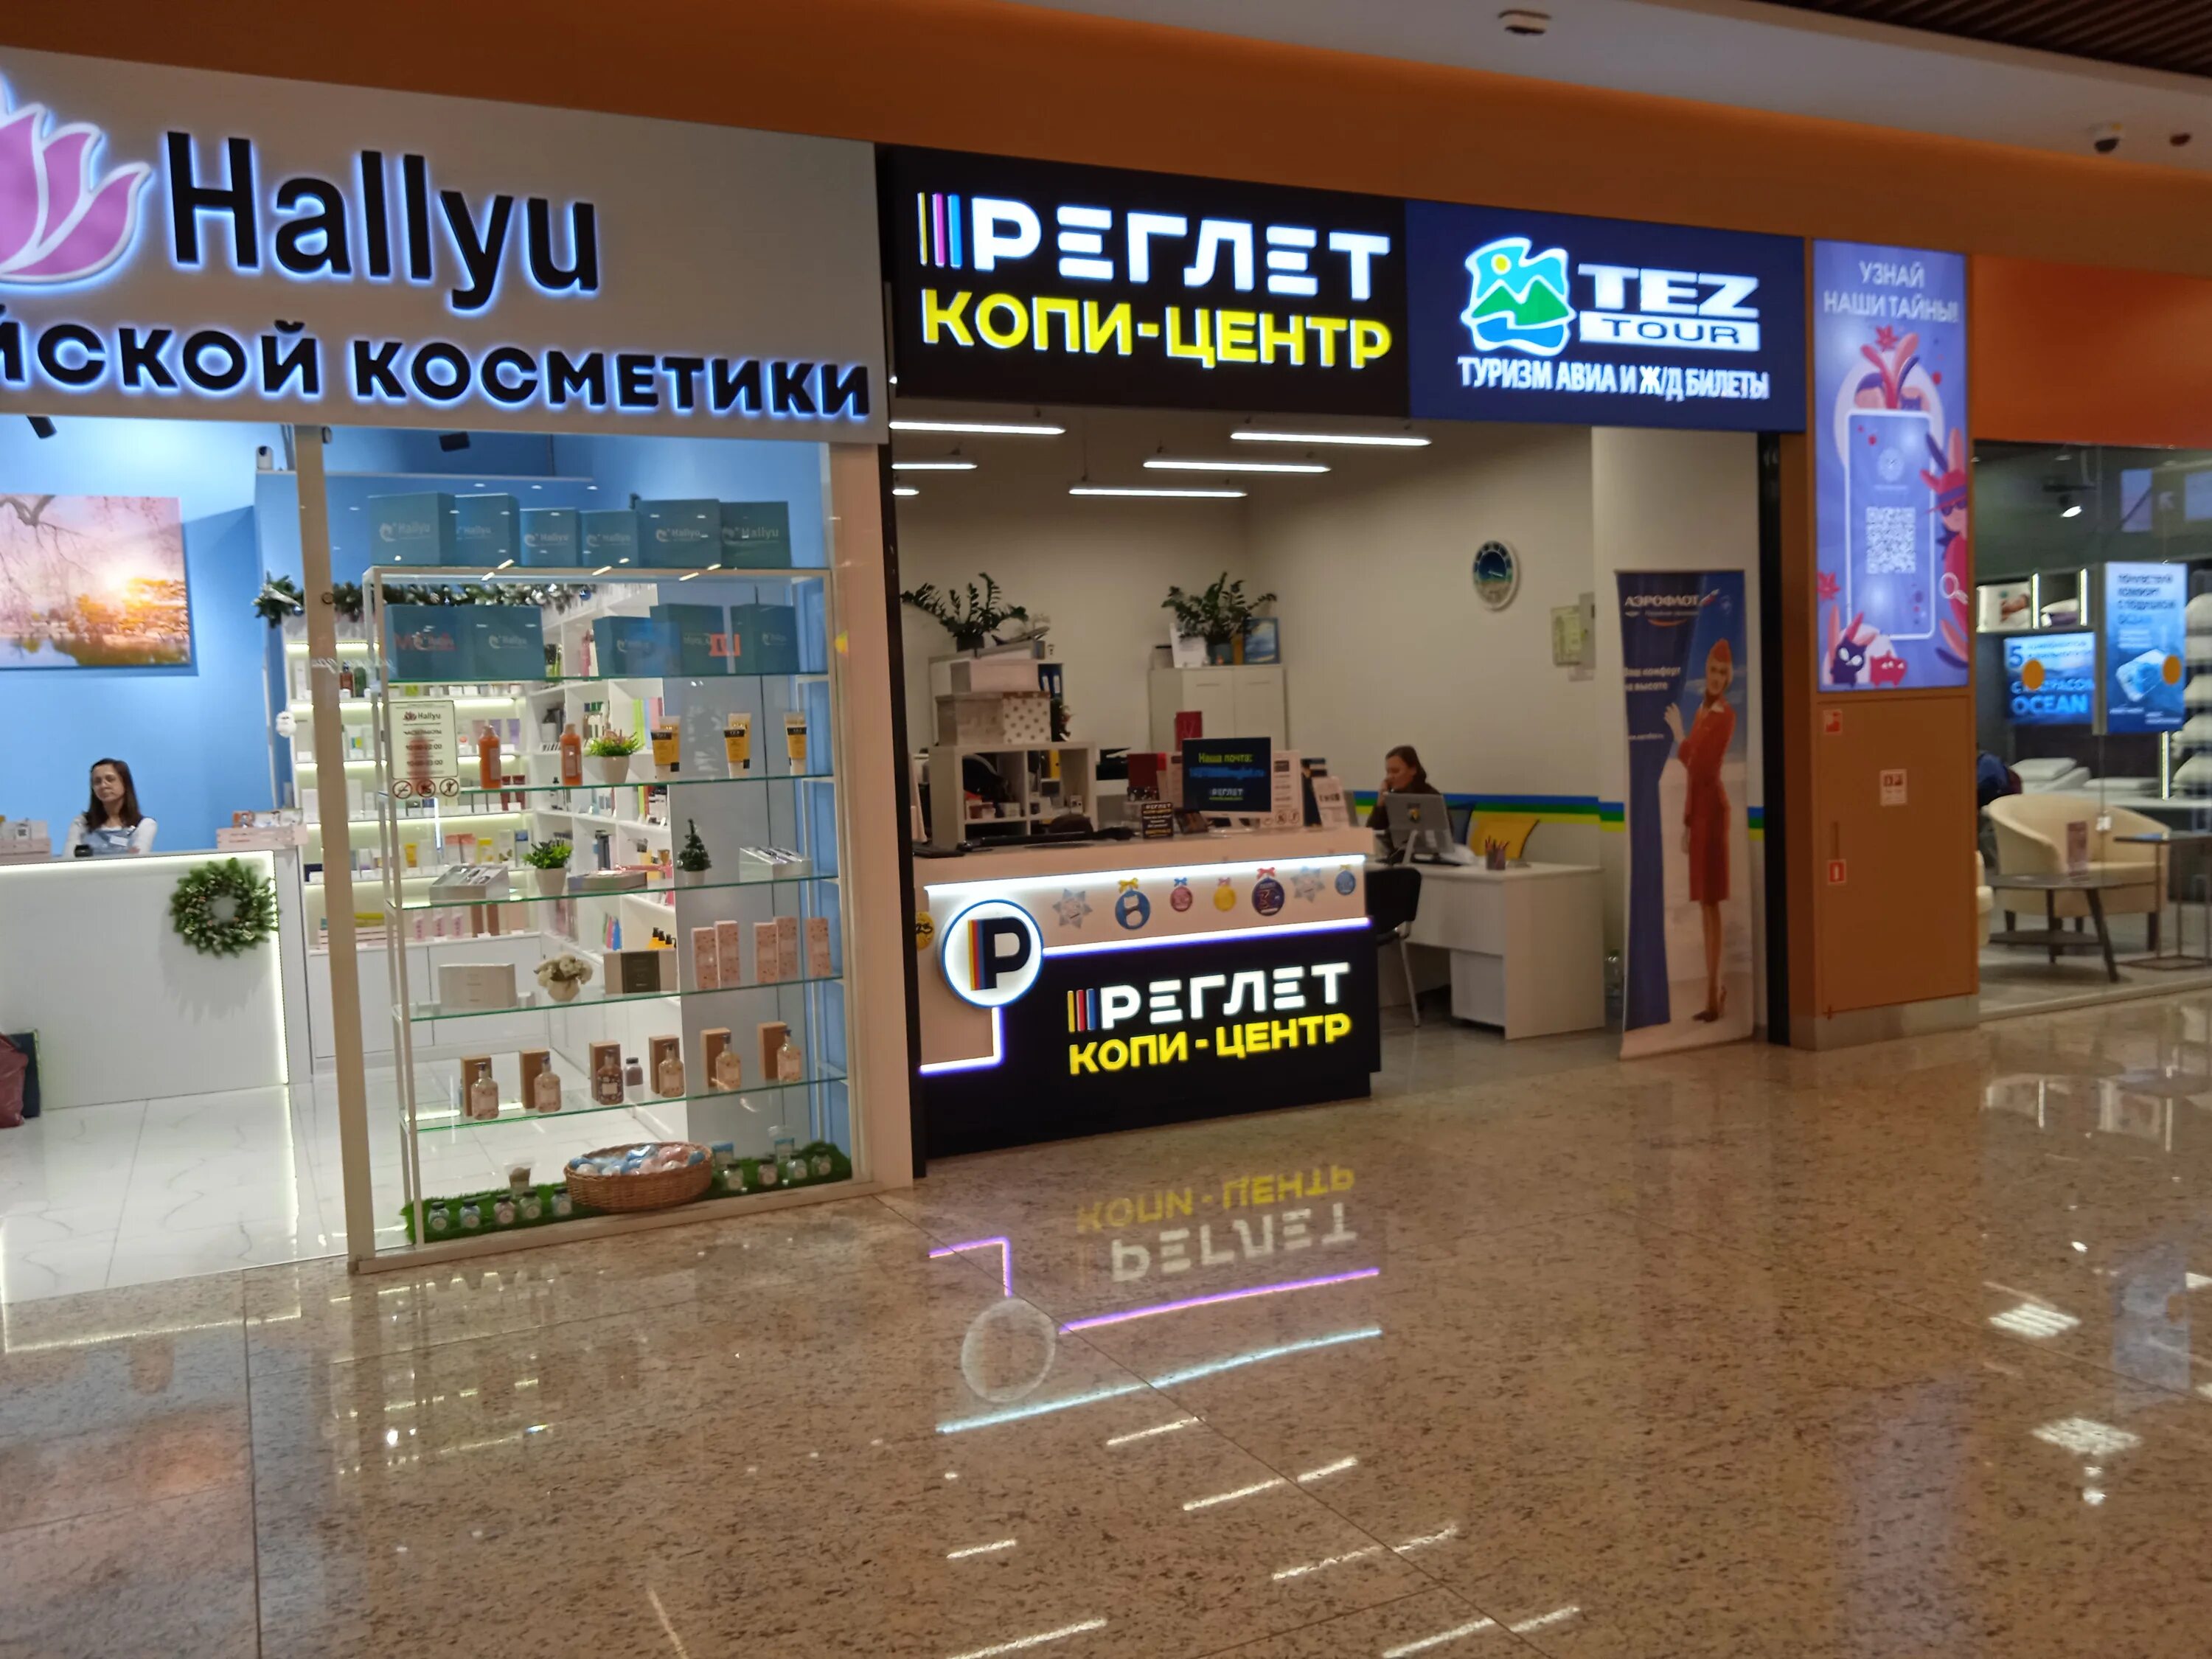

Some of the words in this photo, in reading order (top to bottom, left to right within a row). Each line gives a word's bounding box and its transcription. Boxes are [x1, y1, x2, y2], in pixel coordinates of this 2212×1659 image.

[167, 131, 598, 310] Hallyu
[971, 196, 1391, 300] РЕГЛЕТ
[1859, 260, 1925, 288] УЗНАЙ
[1577, 263, 1760, 319] TEZ
[1823, 290, 1886, 317] НАШИ
[1888, 293, 1959, 323] ТАЙНЫ!
[922, 288, 1392, 369] КОПИ-ЦЕНТР
[1601, 319, 1740, 344] TOUR
[354, 340, 869, 417] КОСМЕТИКИ
[1457, 356, 1552, 389] ТУРИЗМ
[1555, 361, 1617, 392] АВИА
[1620, 365, 1637, 394] И
[1639, 366, 1685, 402] Ж/Д
[1686, 367, 1769, 400] БИЛЕТЫ
[1625, 594, 1699, 607] АЭРОФЛОТ
[2008, 646, 2023, 667] 5
[417, 712, 442, 720] Hallyu
[2011, 694, 2089, 714] OCEAN
[1198, 752, 1222, 764] Наша
[1224, 754, 1253, 763] почта:
[1101, 962, 1351, 1029] РЕГЛЕТ
